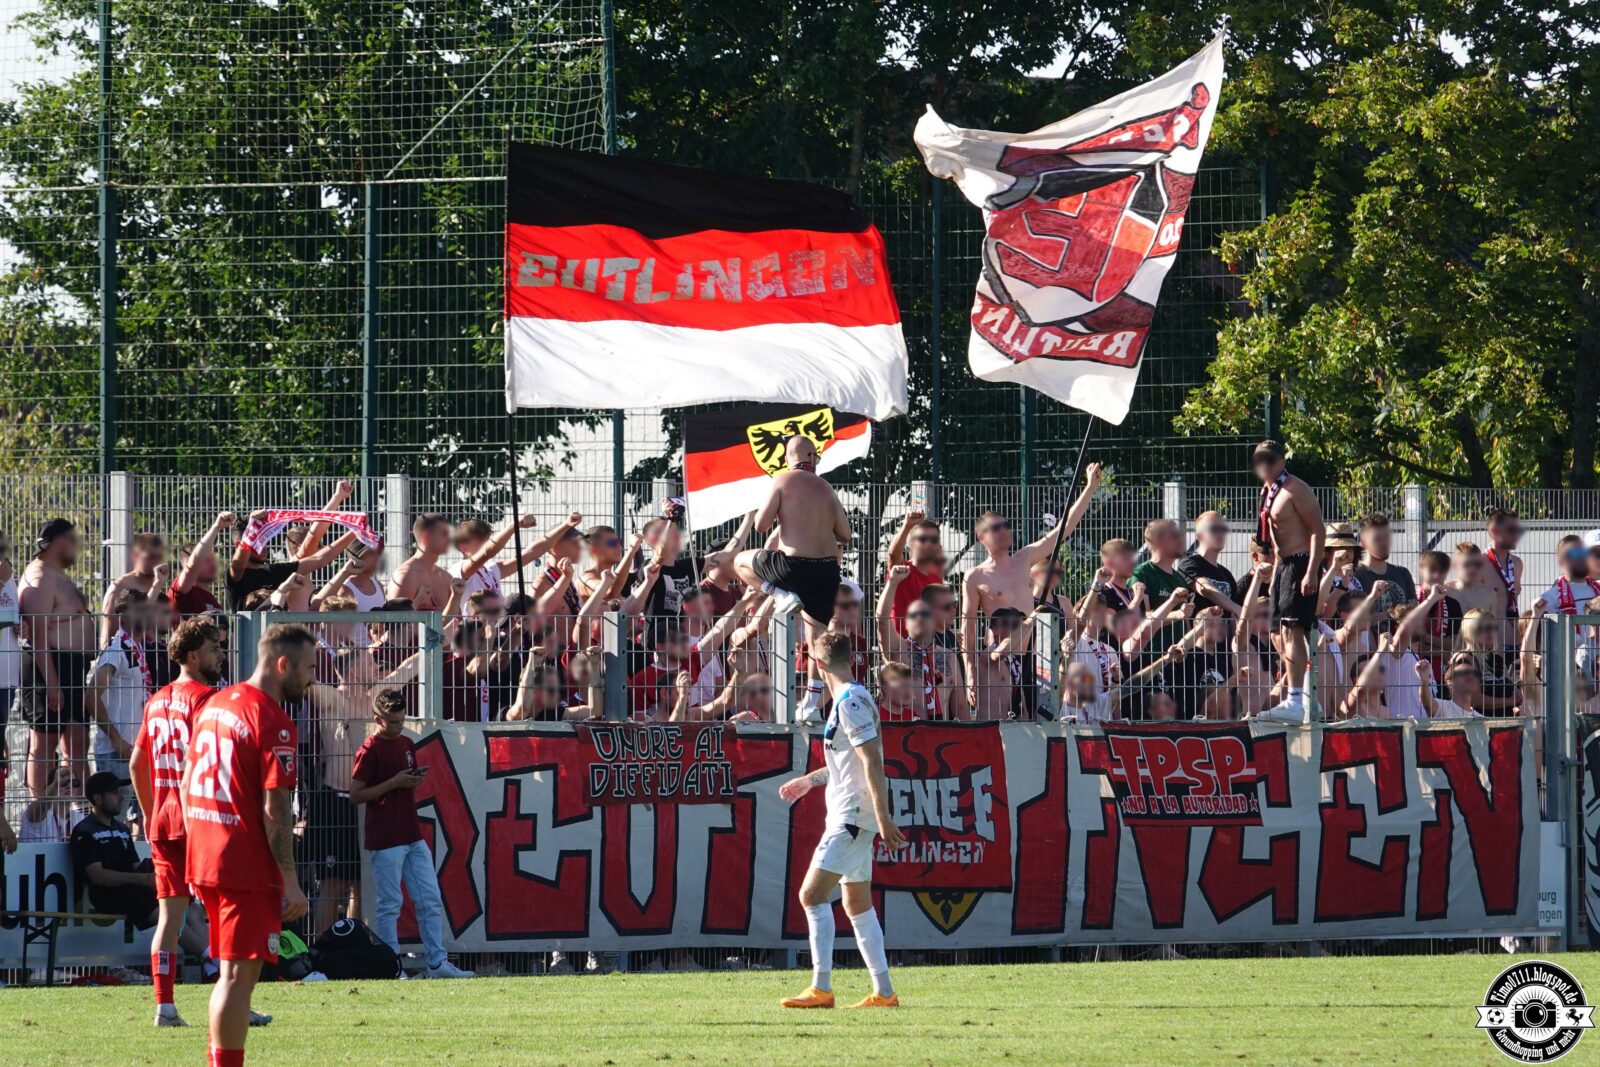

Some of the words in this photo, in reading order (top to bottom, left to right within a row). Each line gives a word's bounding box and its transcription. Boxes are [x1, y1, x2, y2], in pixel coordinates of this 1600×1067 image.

[148, 717, 190, 772] 23
[694, 726, 725, 760] AI
[189, 730, 234, 804] 21
[589, 761, 734, 797] DIFFIDATI
[1108, 734, 1247, 799] TPSP
[1127, 795, 1148, 815] NO
[1149, 795, 1161, 815] A
[1162, 795, 1181, 815] LA
[1183, 793, 1249, 815] AUTORIDAD
[872, 840, 986, 864] EUTLINGEN
